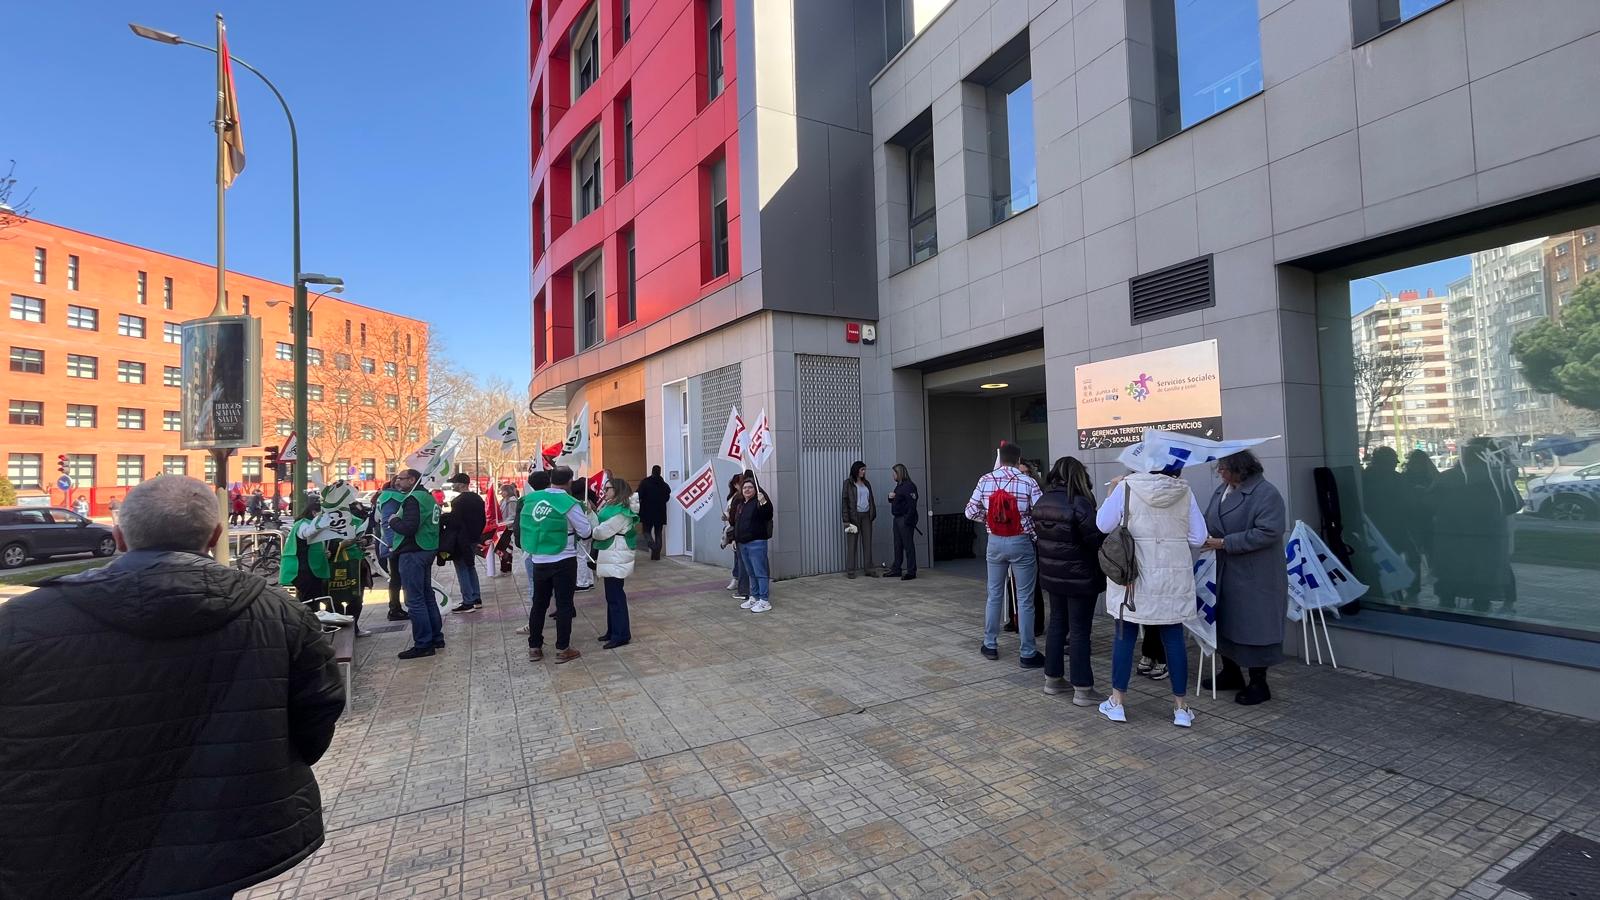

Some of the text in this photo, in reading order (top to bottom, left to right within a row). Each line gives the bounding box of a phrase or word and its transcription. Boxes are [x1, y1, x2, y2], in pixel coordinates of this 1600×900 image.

[1156, 372, 1216, 387] Servicios Sociales
[593, 410, 601, 438] 5
[1091, 429, 1119, 437] GERENCIA
[1167, 421, 1203, 431] SERVICIOS
[1112, 434, 1140, 444] SOCIALES
[535, 505, 553, 516] CSIF
